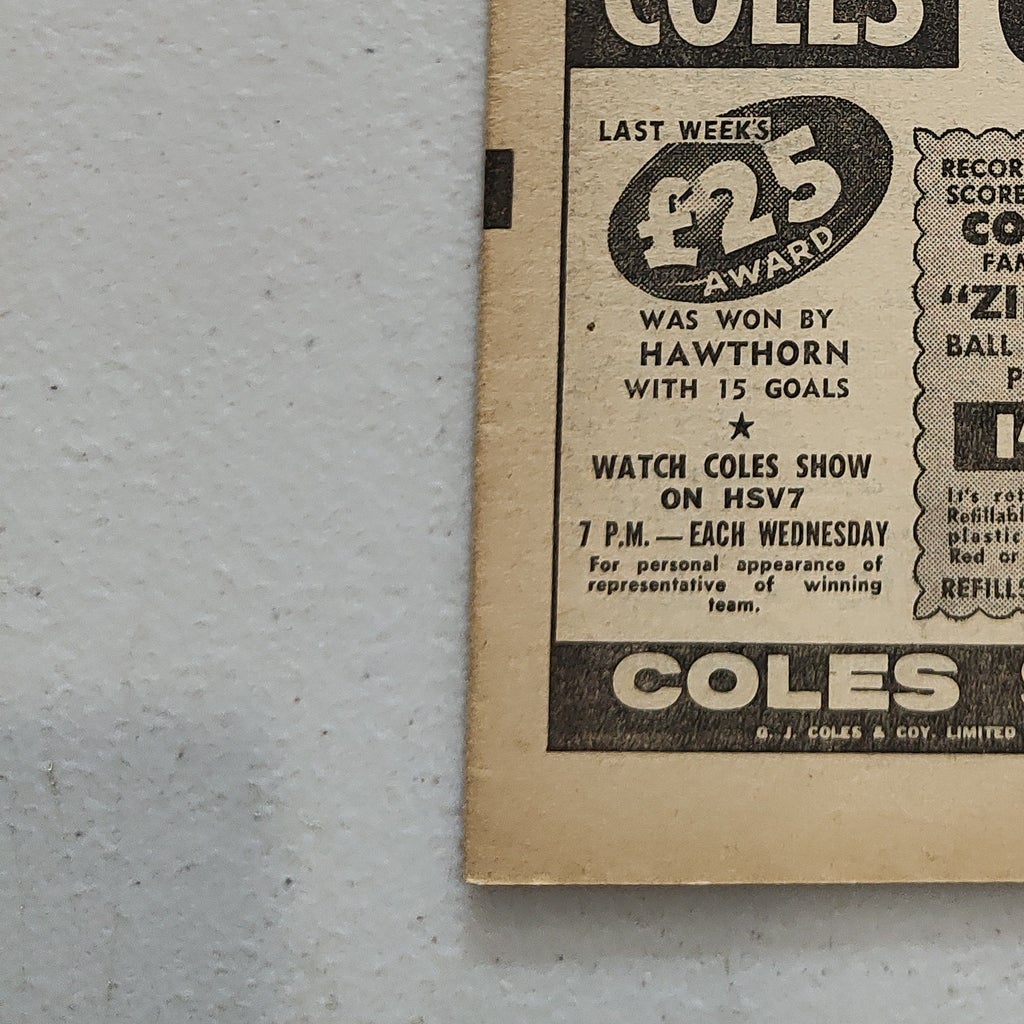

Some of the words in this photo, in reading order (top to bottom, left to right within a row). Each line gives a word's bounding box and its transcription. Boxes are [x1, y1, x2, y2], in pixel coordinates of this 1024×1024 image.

[600, 120, 665, 141] LAST
[679, 119, 770, 141] WEEK'S
[637, 125, 842, 268] £25
[703, 226, 833, 296] AWARD
[640, 309, 698, 330] WAS
[716, 309, 781, 330] WON
[800, 309, 833, 329] BY
[640, 340, 849, 366] HAWTHORN
[946, 333, 1012, 357] BALL
[624, 379, 697, 399] WITH
[719, 379, 746, 400] 15
[765, 378, 849, 399] GOALS
[592, 454, 687, 479] WATCH
[704, 453, 779, 479] COLES
[796, 454, 872, 479] SHOW
[661, 487, 702, 510] ON
[724, 487, 804, 509] HSV7
[948, 487, 979, 503] It's
[579, 521, 591, 547] 7
[759, 520, 889, 547] WEDNESDAY
[948, 527, 1021, 545] plastic
[589, 556, 620, 572] For
[637, 554, 719, 574] personal
[736, 560, 846, 575] appearance
[863, 555, 883, 572] of
[950, 547, 985, 564] Red
[1000, 550, 1018, 564] or
[588, 577, 726, 595] representative
[754, 576, 775, 593] of
[803, 577, 882, 595] winning
[612, 651, 961, 711] COLES
[784, 726, 797, 739] J.
[808, 726, 862, 739] COLES
[873, 726, 885, 739] &
[896, 726, 937, 739] COY.
[947, 726, 1016, 739] LIMITED
